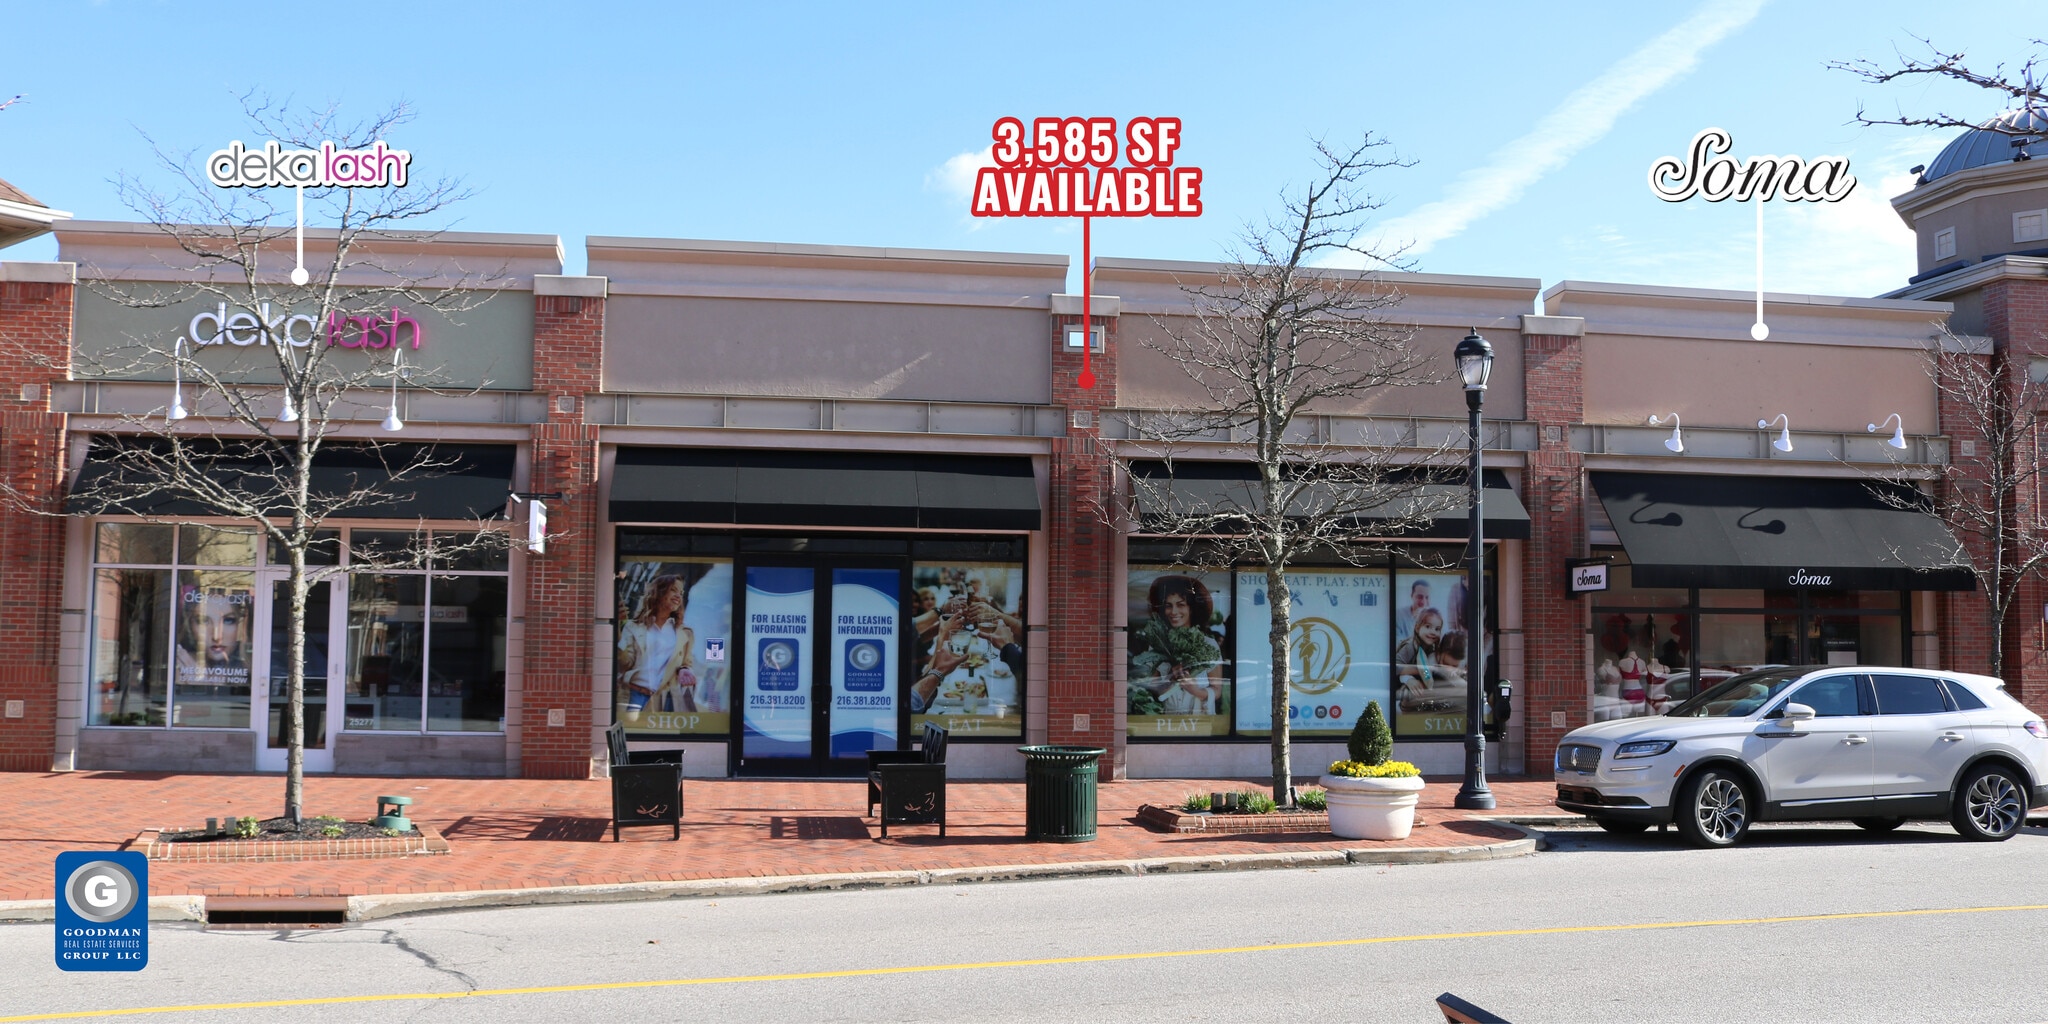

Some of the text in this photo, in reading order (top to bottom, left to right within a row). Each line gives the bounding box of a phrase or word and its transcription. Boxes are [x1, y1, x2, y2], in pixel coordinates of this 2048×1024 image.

[1240, 575, 1269, 586] SHO
[1316, 577, 1349, 587] PLAY.
[1353, 577, 1386, 588] STAY.
[1576, 568, 1602, 586] Soma
[1788, 568, 1832, 586] Soma
[751, 614, 807, 624] FOR LEASING
[838, 615, 893, 625] FOR LEASING
[751, 624, 807, 634] INFORMATION
[838, 625, 893, 635] INFORMATION
[857, 649, 873, 664] G
[180, 667, 249, 676] MEGAVOLUME
[750, 695, 806, 705] 216.381.8200
[836, 696, 892, 706] 216.381.8200
[647, 715, 700, 729] SHOP
[948, 718, 985, 732] EAT
[1156, 718, 1199, 732] PLAY
[1424, 717, 1464, 731] STAY
